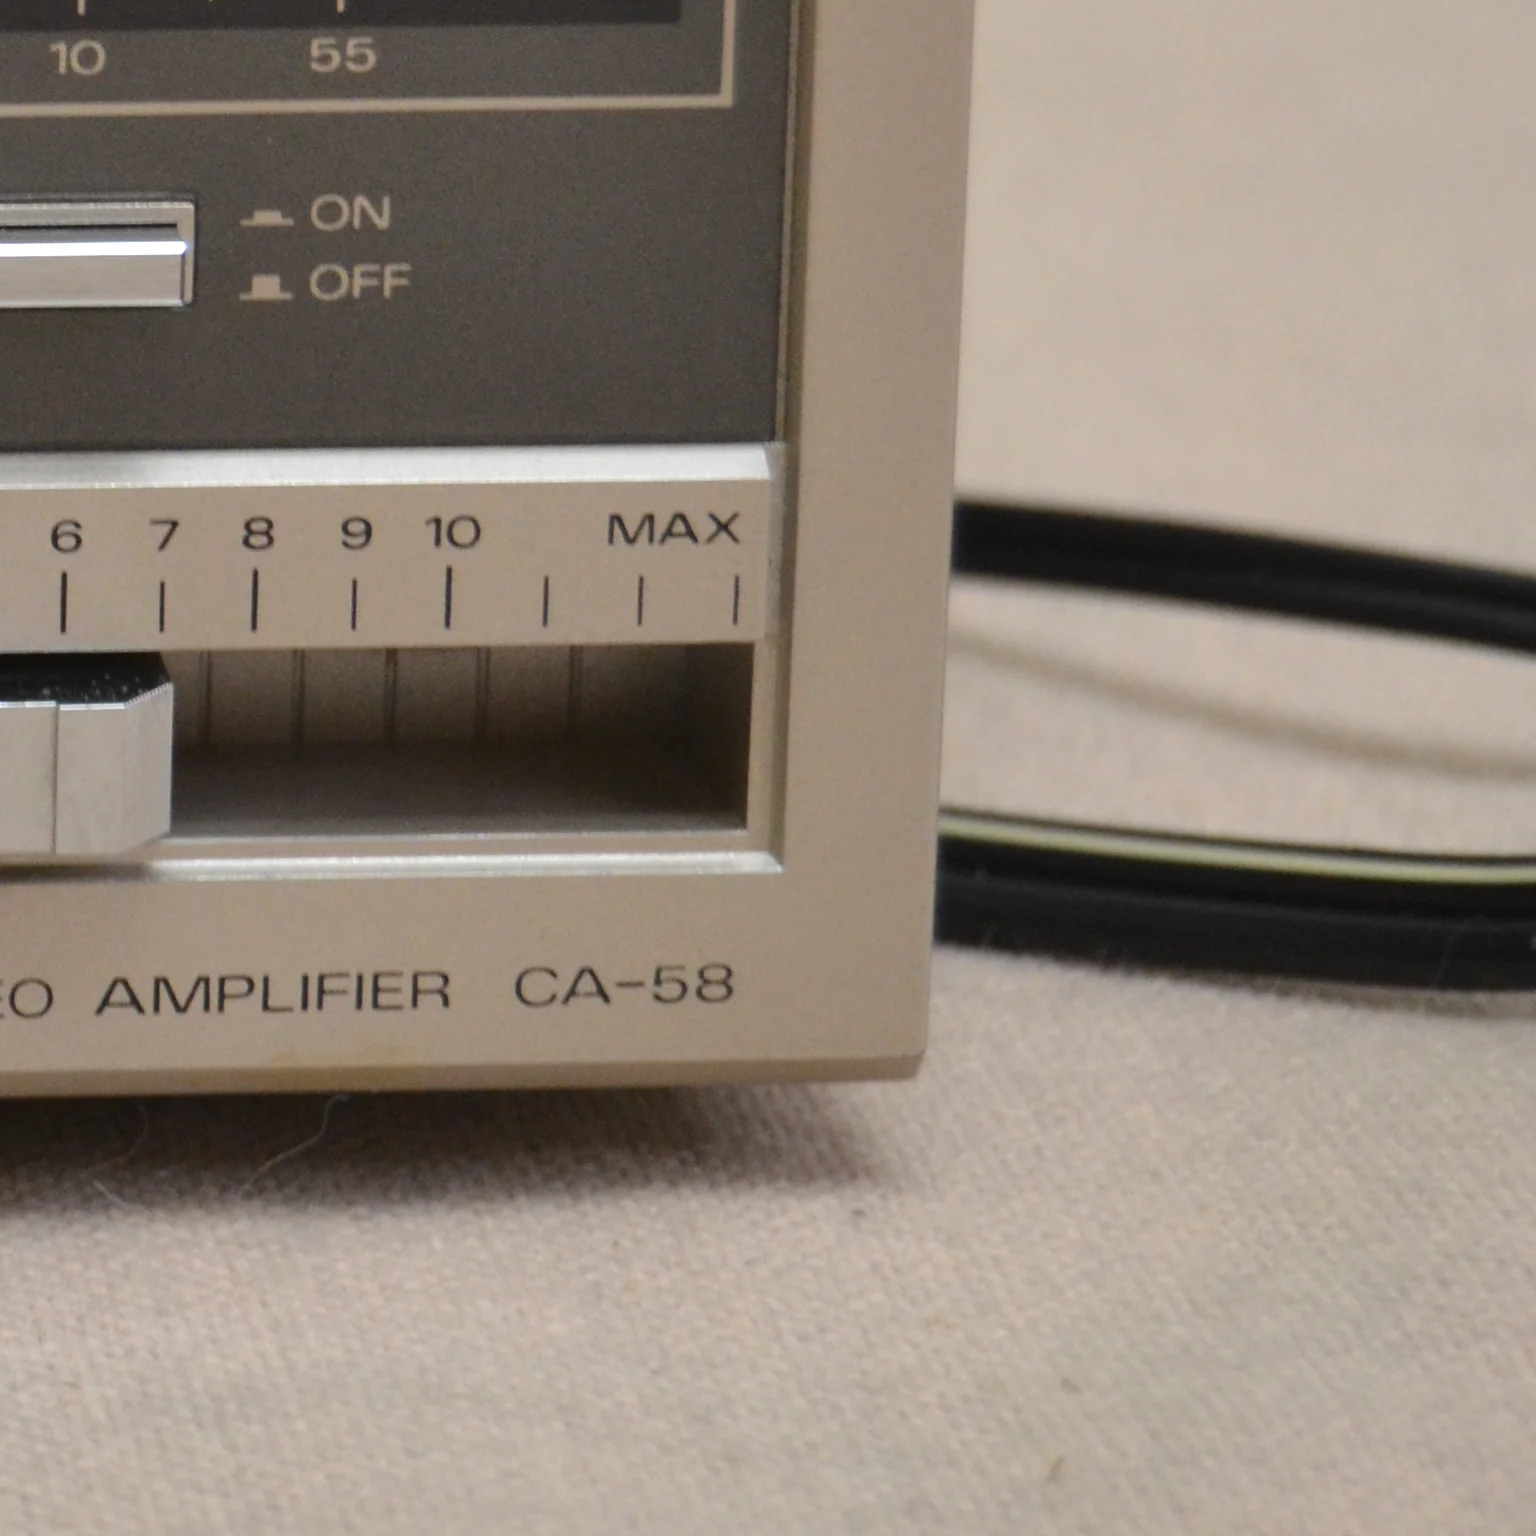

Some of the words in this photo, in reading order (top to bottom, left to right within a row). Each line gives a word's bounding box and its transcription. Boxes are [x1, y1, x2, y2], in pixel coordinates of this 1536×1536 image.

[50, 39, 106, 76] 10
[310, 37, 377, 73] 55
[310, 194, 391, 231] ON
[309, 263, 411, 301] OFF
[50, 520, 83, 553] 6
[150, 519, 180, 551] 7
[242, 516, 275, 551] 8
[340, 517, 373, 550] 9
[426, 515, 482, 549] 10
[607, 512, 740, 546] MAX
[95, 972, 450, 1016] AMPLIFIER
[514, 964, 734, 1007] CA-58
